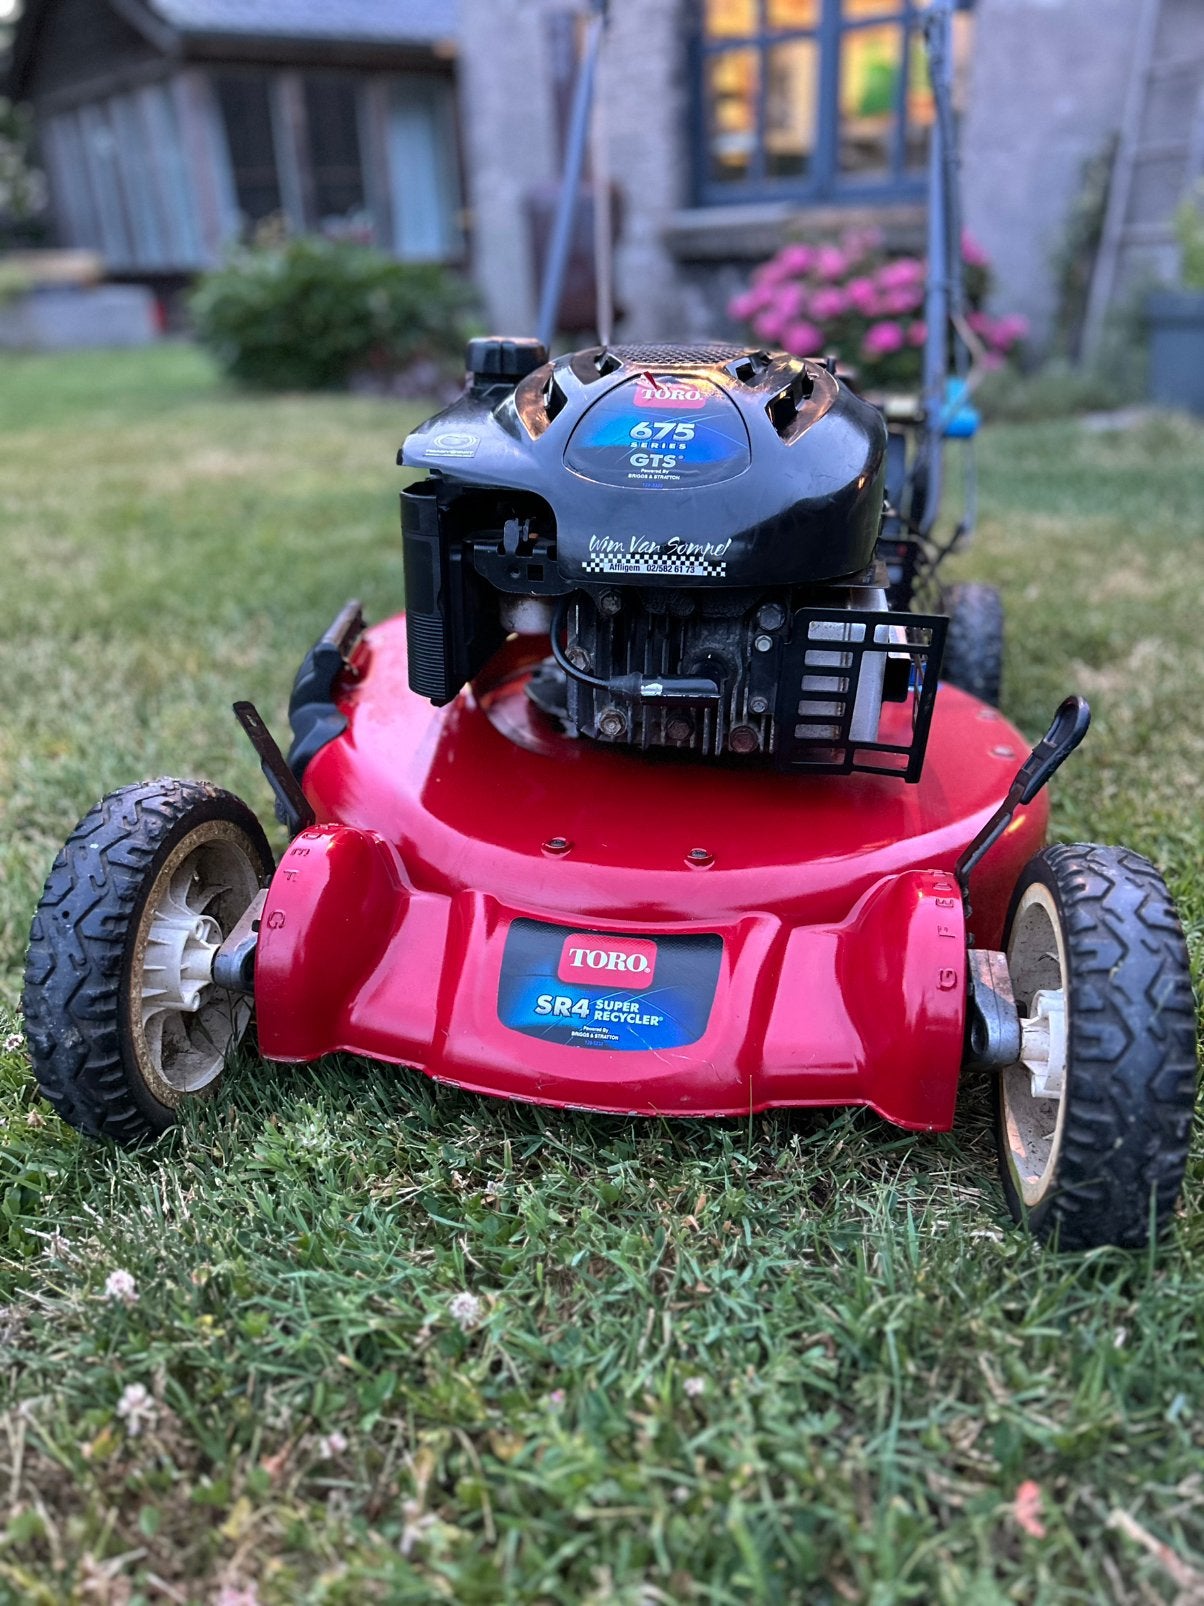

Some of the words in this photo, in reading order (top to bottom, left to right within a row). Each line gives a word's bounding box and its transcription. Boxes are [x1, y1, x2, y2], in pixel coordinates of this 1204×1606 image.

[641, 388, 702, 400] TORO
[629, 421, 695, 441] 675
[630, 442, 687, 450] SERIES
[629, 453, 677, 468] GTS
[588, 534, 625, 552] Wim
[629, 535, 660, 554] Van
[609, 564, 640, 573] Affligem
[646, 564, 673, 573] 02/582
[674, 565, 683, 573] 61
[685, 566, 695, 574] 73
[568, 948, 649, 973] TORO
[535, 994, 590, 1018] SR4
[595, 999, 640, 1013] SUPER
[593, 1010, 661, 1026] RECYCLER
